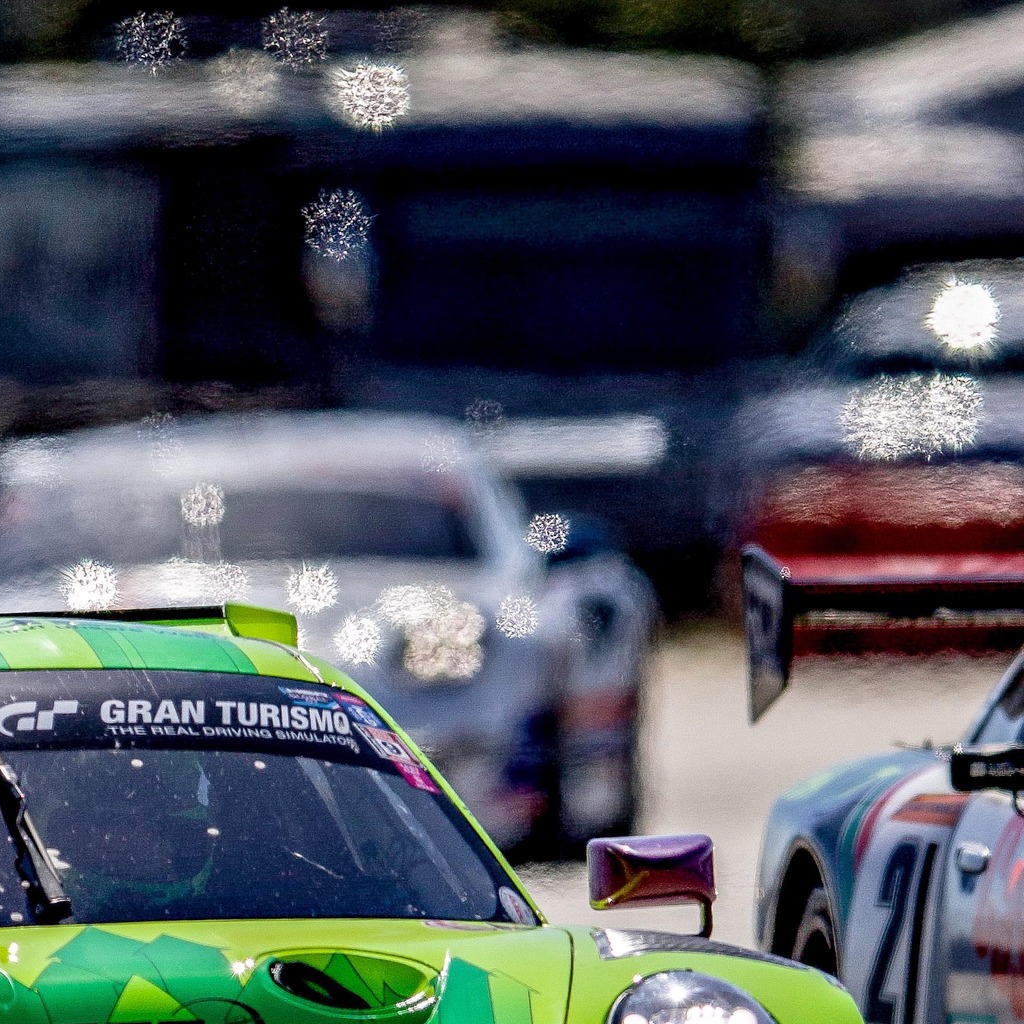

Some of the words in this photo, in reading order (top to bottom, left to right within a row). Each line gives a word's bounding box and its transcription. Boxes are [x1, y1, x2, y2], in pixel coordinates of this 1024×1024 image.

[100, 699, 205, 725] GRAN
[215, 700, 352, 735] TURISMO
[107, 725, 147, 736] THE
[151, 726, 200, 737] REAL
[203, 727, 272, 739] DRIVING
[276, 730, 358, 749] SIMULATOR
